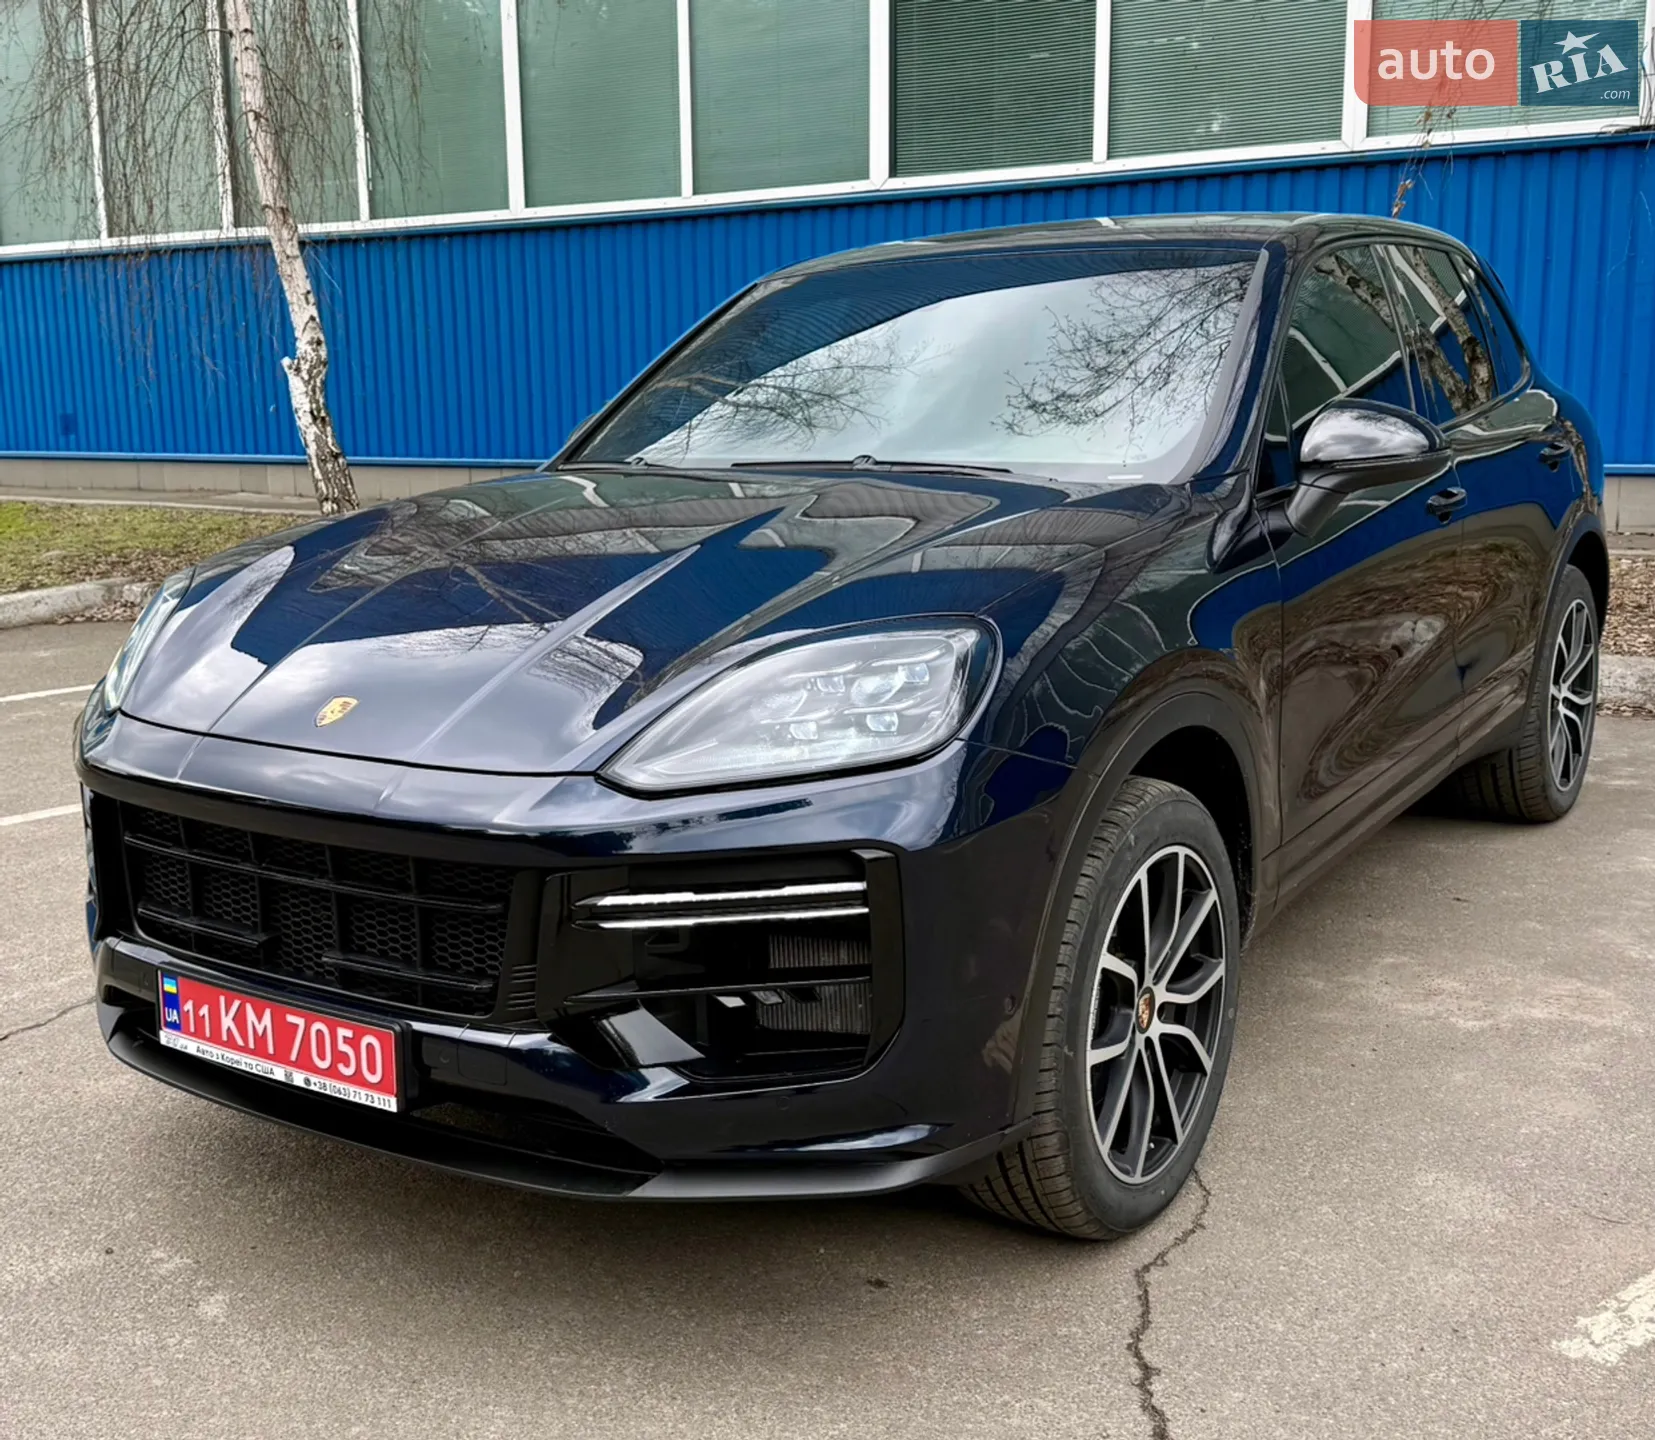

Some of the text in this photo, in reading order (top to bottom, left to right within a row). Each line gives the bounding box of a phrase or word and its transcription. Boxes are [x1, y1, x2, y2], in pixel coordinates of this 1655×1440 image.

[165, 1006, 180, 1024] UA
[183, 995, 383, 1084] 11 KM 7050
[196, 1045, 214, 1058] Авто
[255, 1063, 275, 1076] США
[313, 1080, 327, 1091] +38
[329, 1083, 350, 1098] (063)
[364, 1093, 375, 1104] 73
